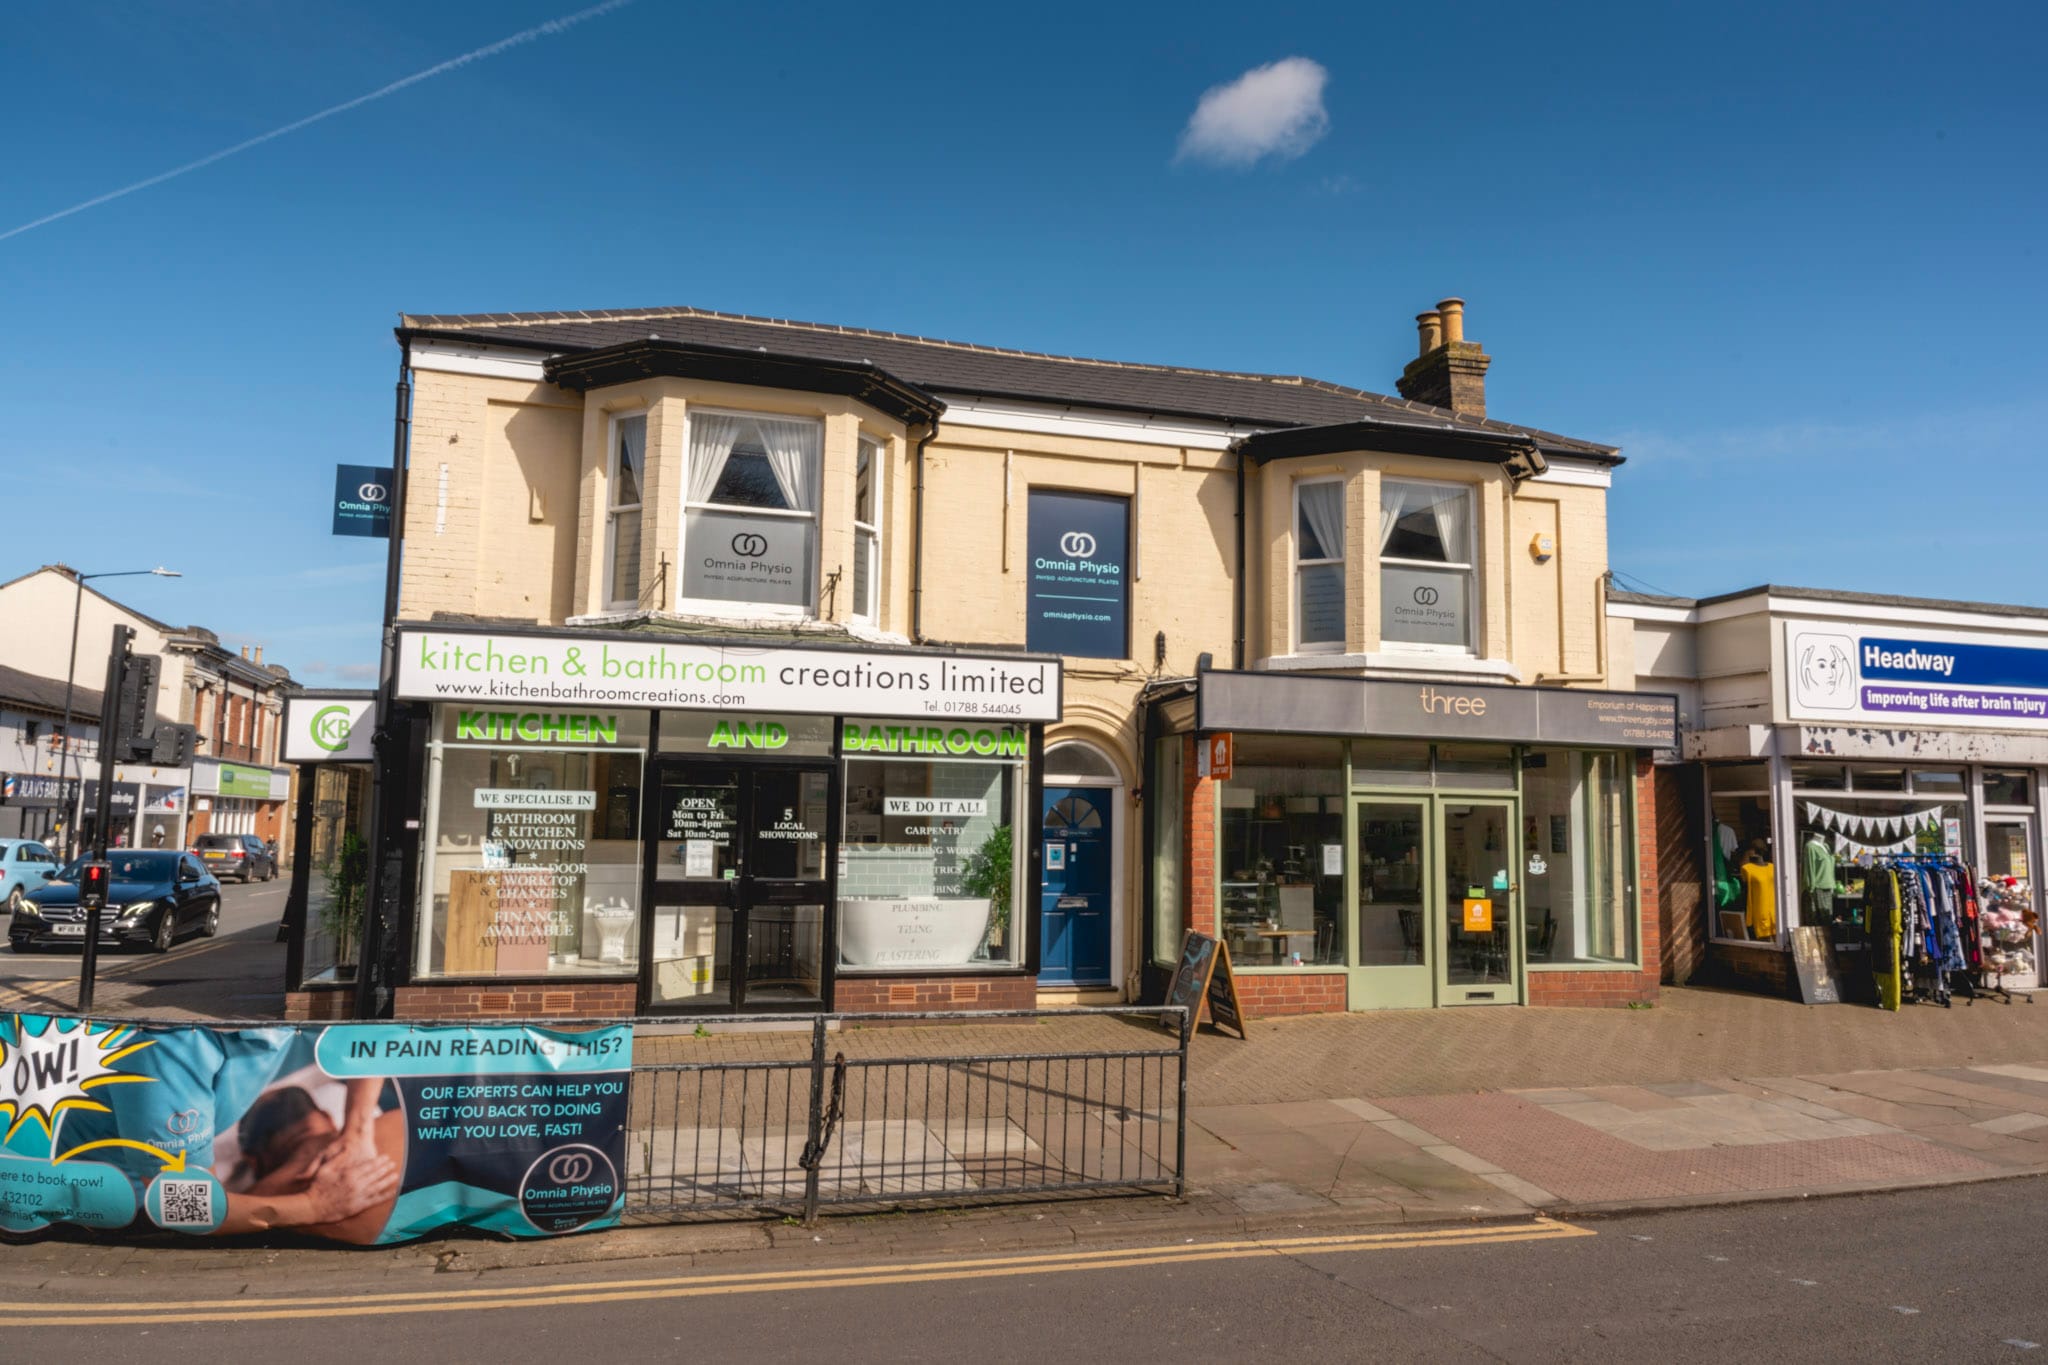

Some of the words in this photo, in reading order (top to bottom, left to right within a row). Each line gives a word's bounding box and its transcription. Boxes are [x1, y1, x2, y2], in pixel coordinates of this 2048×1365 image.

[339, 501, 370, 511] Omnia
[704, 558, 746, 570] Omnia
[750, 561, 792, 575] Physio
[1035, 558, 1076, 571] Omnia
[1080, 561, 1120, 576] Physio
[1043, 611, 1112, 622] omniaphysio.com
[1394, 606, 1424, 616] Omnia
[1426, 608, 1455, 619] Physio
[420, 636, 549, 675] kitchen
[562, 647, 587, 676] &
[602, 645, 767, 684] bathroom
[779, 662, 930, 692] creations
[942, 661, 1044, 695] limited
[1864, 645, 1955, 676] Headway
[435, 679, 745, 705] www.kitchenbathroomcreations.com
[923, 700, 941, 712] Tel.
[944, 701, 978, 714] 01788
[981, 703, 1022, 715] 544045
[1420, 687, 1487, 716] three
[1867, 690, 1928, 709] improving
[1930, 692, 1950, 708] life
[1952, 693, 1979, 709] after
[1981, 695, 2011, 710] brain
[2013, 696, 2046, 715] injury
[456, 711, 617, 743] KITCHEN
[707, 720, 789, 749] AND
[842, 723, 1029, 757] BATHROOM
[481, 794, 499, 803] WE
[503, 794, 573, 805] SPECIALISE
[578, 795, 591, 805] IN
[682, 798, 715, 809] OPEN
[889, 801, 910, 812] WE
[916, 801, 935, 812] DO
[939, 802, 951, 812] IT
[958, 802, 983, 813] ALL
[493, 813, 576, 825] BATHROOM
[672, 810, 694, 820] Mon
[697, 812, 707, 820] to
[710, 810, 725, 820] Fri
[784, 809, 793, 821] 5
[673, 820, 722, 829] 10am-4pm
[774, 822, 806, 830] LOCAL
[905, 826, 966, 835] CARPENTRY
[492, 826, 503, 837] &
[508, 826, 577, 837] KITCHEN
[667, 830, 682, 838] Sat
[684, 830, 730, 839] 10am-2pm
[759, 831, 819, 839] SHOWROOMS
[946, 846, 977, 855] WORK
[548, 863, 588, 873] DOOR
[487, 876, 498, 886] &
[504, 875, 577, 886] WORKTOP
[496, 888, 567, 899] CHANGES
[495, 911, 568, 922] FINANCE
[485, 924, 574, 936] AVAILABLE
[351, 1041, 376, 1058] IN
[385, 1039, 441, 1057] PAIN
[451, 1038, 556, 1056] READING
[564, 1037, 623, 1057] THIS?
[13, 1038, 80, 1096] OW!
[421, 1087, 453, 1099] OUR
[457, 1085, 518, 1098] EXPERTS
[521, 1084, 552, 1097] CAN
[556, 1083, 591, 1096] HELP
[595, 1082, 623, 1095] YOU
[419, 1107, 449, 1120] GET
[452, 1106, 484, 1118] YOU
[487, 1105, 527, 1117] BACK
[531, 1104, 551, 1116] TO
[554, 1102, 602, 1116] DOING
[418, 1126, 459, 1140] WHAT
[464, 1125, 496, 1139] YOU
[500, 1124, 541, 1138] LOVE,
[545, 1123, 582, 1136] FAST!
[147, 1139, 185, 1150] Omnia
[22, 1173, 34, 1183] to
[37, 1171, 67, 1186] book
[71, 1176, 104, 1187] now!
[525, 1187, 567, 1200] Omnia
[571, 1183, 612, 1198] Physio
[2, 1191, 43, 1206] 432102
